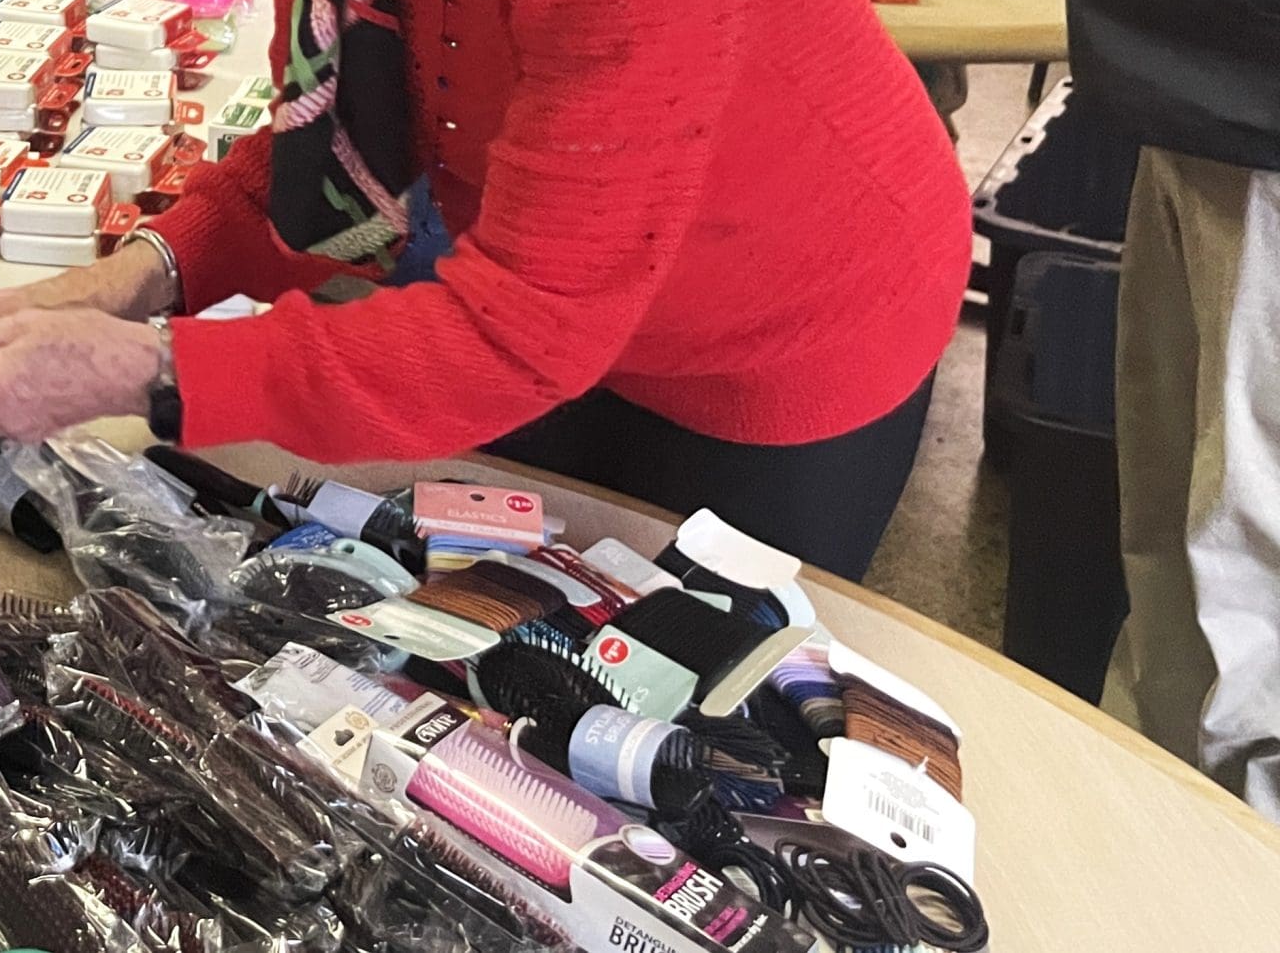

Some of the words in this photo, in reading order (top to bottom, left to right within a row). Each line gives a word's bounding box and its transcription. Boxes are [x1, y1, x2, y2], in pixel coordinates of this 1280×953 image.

[446, 509, 507, 524] ELASTICS
[662, 868, 725, 922] BRUSH
[609, 927, 666, 953] BRU
